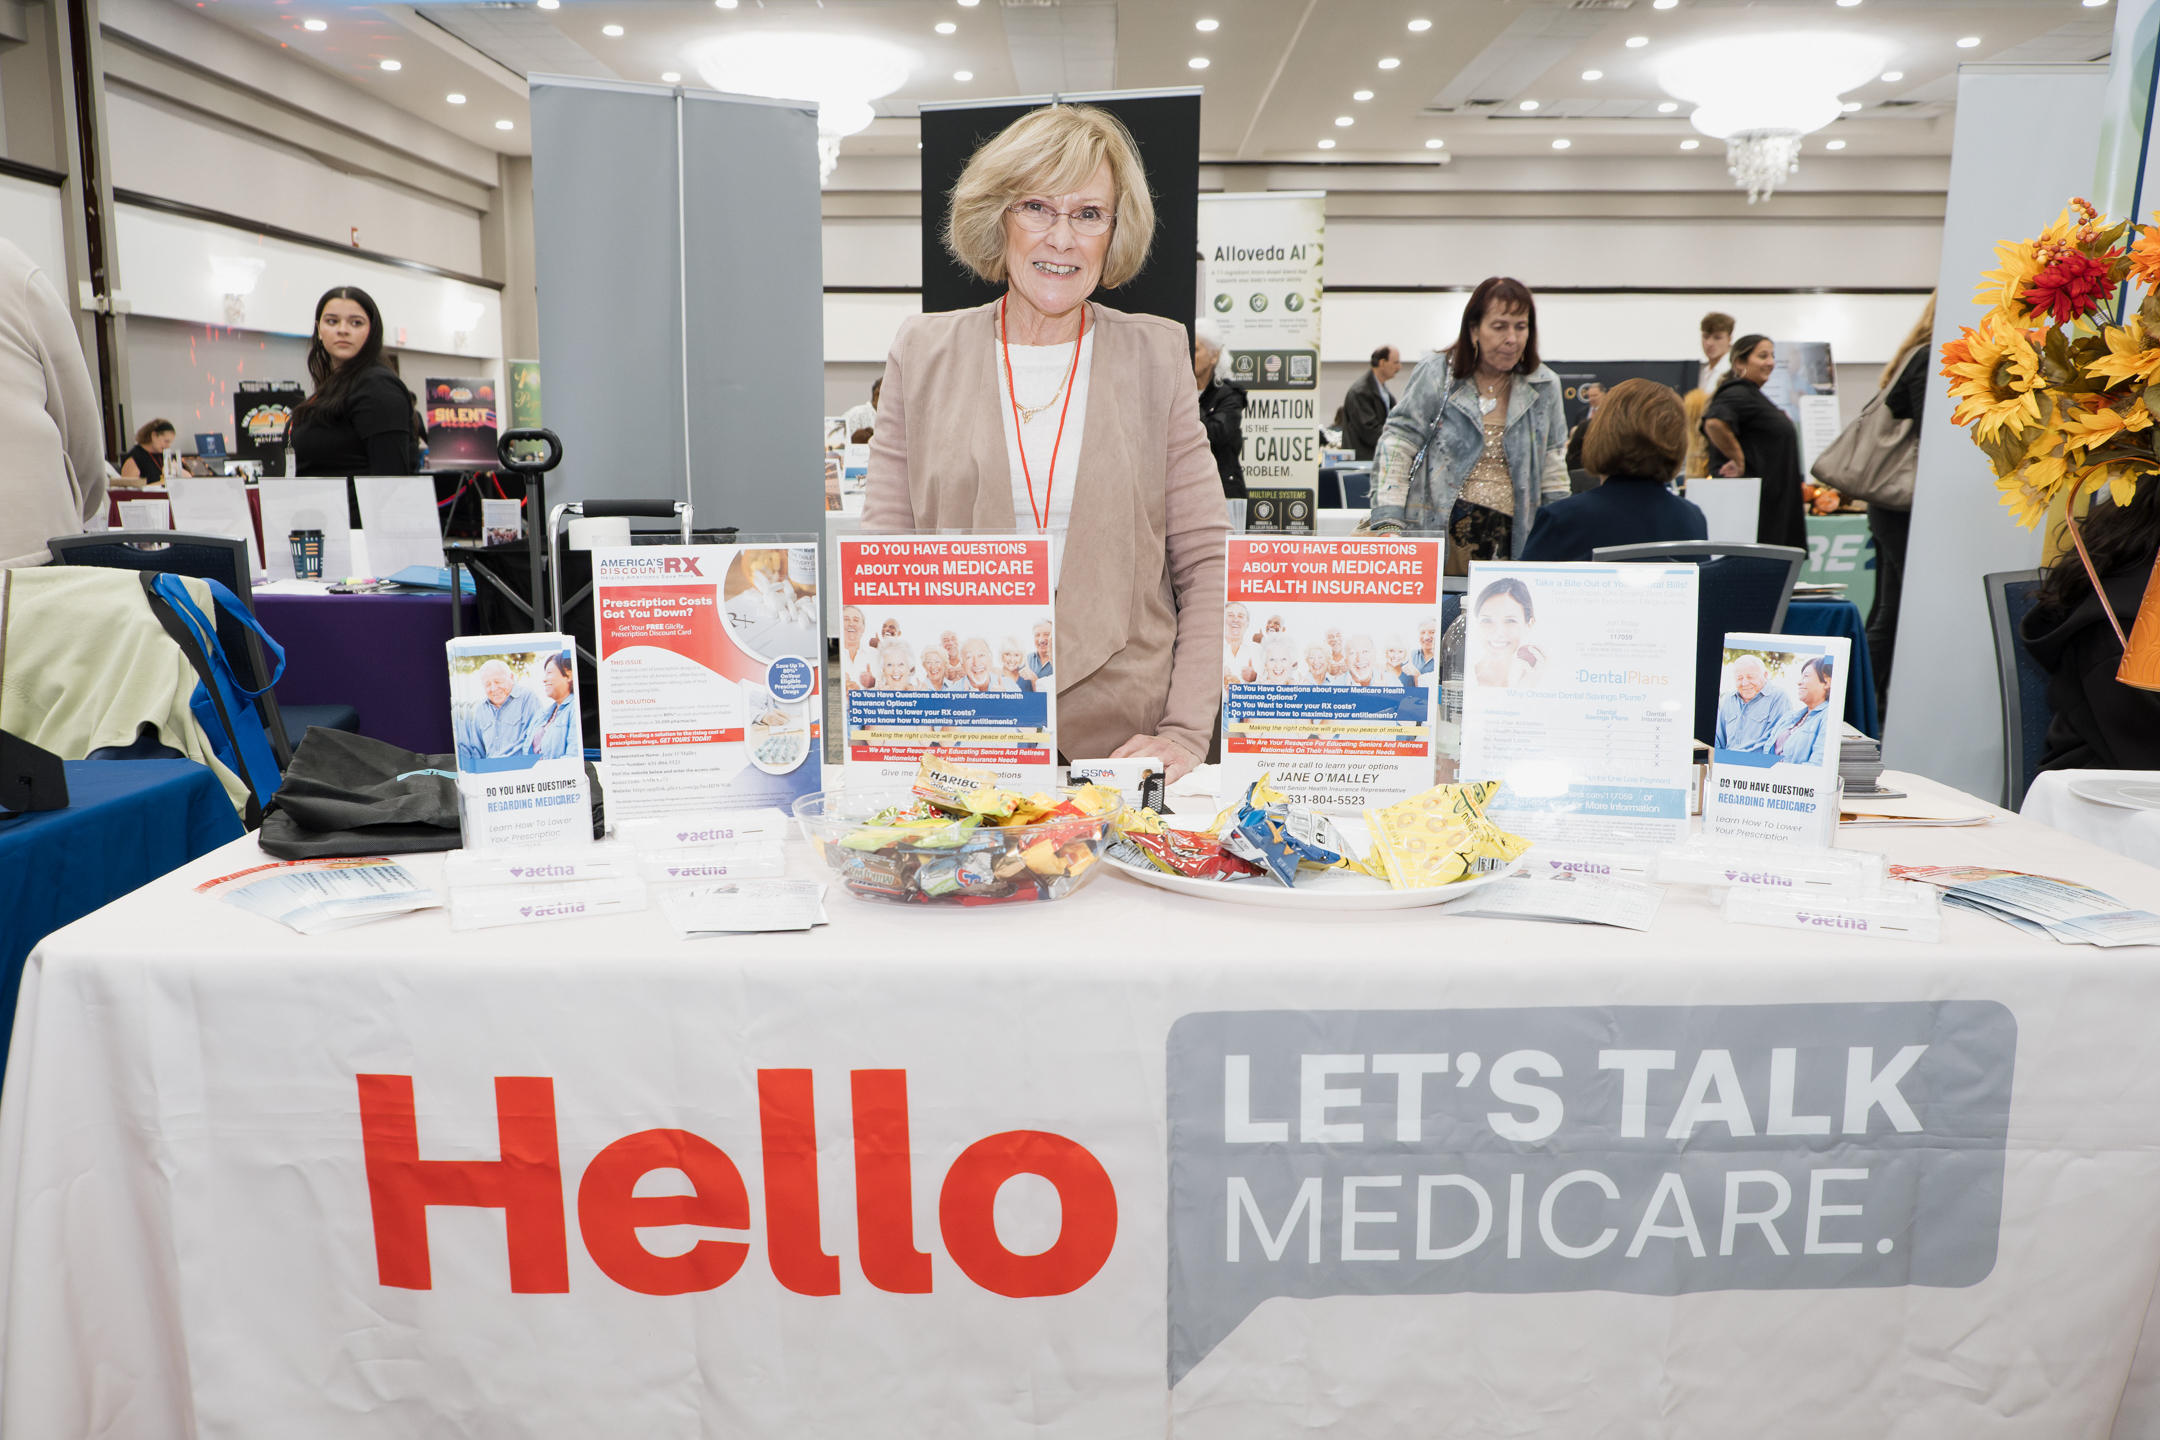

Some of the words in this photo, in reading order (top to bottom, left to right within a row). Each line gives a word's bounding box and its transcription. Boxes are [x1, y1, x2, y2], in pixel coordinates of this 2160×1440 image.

[1214, 245, 1285, 261] Alloveda
[435, 407, 490, 422] SILENT
[1244, 399, 1313, 419] MMATION
[1245, 424, 1252, 433] IS
[1253, 424, 1269, 433] THE
[1255, 436, 1314, 462] CAUSE
[1249, 491, 1277, 499] MULTIPLE
[1278, 491, 1306, 499] SYSTEMS
[860, 544, 879, 556] DO
[882, 544, 910, 555] YOU
[913, 543, 948, 555] HAVE
[950, 543, 1027, 556] QUESTIONS
[1249, 543, 1268, 554] DO
[1272, 543, 1299, 554] YOU
[1303, 543, 1337, 555] HAVE
[1341, 543, 1417, 556] QUESTIONS
[600, 558, 663, 567] AMERICA'S
[664, 557, 704, 577] RX
[600, 567, 664, 575] DISCOUNT
[855, 564, 899, 575] ABOUT
[903, 564, 939, 575] YOUR
[942, 560, 1034, 575] MEDICARE
[1242, 562, 1287, 573] ABOUT
[1291, 562, 1327, 574] YOUR
[1332, 560, 1422, 574] MEDICARE
[854, 582, 920, 596] HEALTH
[925, 582, 1036, 596] INSURANCE?
[1240, 580, 1307, 594] HEALTH
[1312, 580, 1424, 595] INSURANCE?
[602, 598, 676, 609] Prescription
[679, 597, 713, 606] Costs
[603, 609, 625, 619] Got
[628, 609, 651, 618] You
[653, 608, 694, 618] Down?
[611, 630, 648, 638] Prescription
[1351, 711, 1398, 719] entitlements?
[1257, 760, 1275, 768] Give
[1368, 763, 1398, 771] options
[1276, 772, 1310, 782] JANE
[1314, 772, 1379, 783] O'MALLEY
[487, 786, 497, 797] DO
[499, 785, 514, 796] YOU
[516, 782, 535, 794] HAVE
[537, 779, 577, 792] QUESTIONS
[1719, 778, 1731, 788] DO
[1732, 779, 1748, 790] YOU
[1750, 781, 1770, 793] HAVE
[1772, 783, 1815, 797] QUESTIONS
[488, 798, 533, 812] REGARDING
[535, 793, 581, 807] MEDICARE?
[1288, 794, 1365, 805] 631-804-5523
[1585, 801, 1604, 810] More
[1610, 802, 1660, 813] Information
[1718, 792, 1765, 808] REGARDING
[1767, 798, 1817, 814] MEDICARE?
[1716, 815, 1740, 824] Learn
[1742, 817, 1761, 826] How
[1764, 820, 1774, 828] To
[1776, 822, 1802, 832] Lower
[690, 828, 733, 842] aetna
[1715, 825, 1733, 835] Your
[1737, 828, 1788, 842] Prescription
[525, 864, 575, 877] aetna
[1563, 860, 1610, 875] aetna
[1739, 870, 1793, 887] aetna
[1811, 912, 1868, 931] aetna
[1223, 1049, 1564, 1143] LET'S
[1597, 1044, 1929, 1139] TALK
[355, 1068, 1118, 1298] Hello
[1225, 1167, 1895, 1263] MEDICARE.
